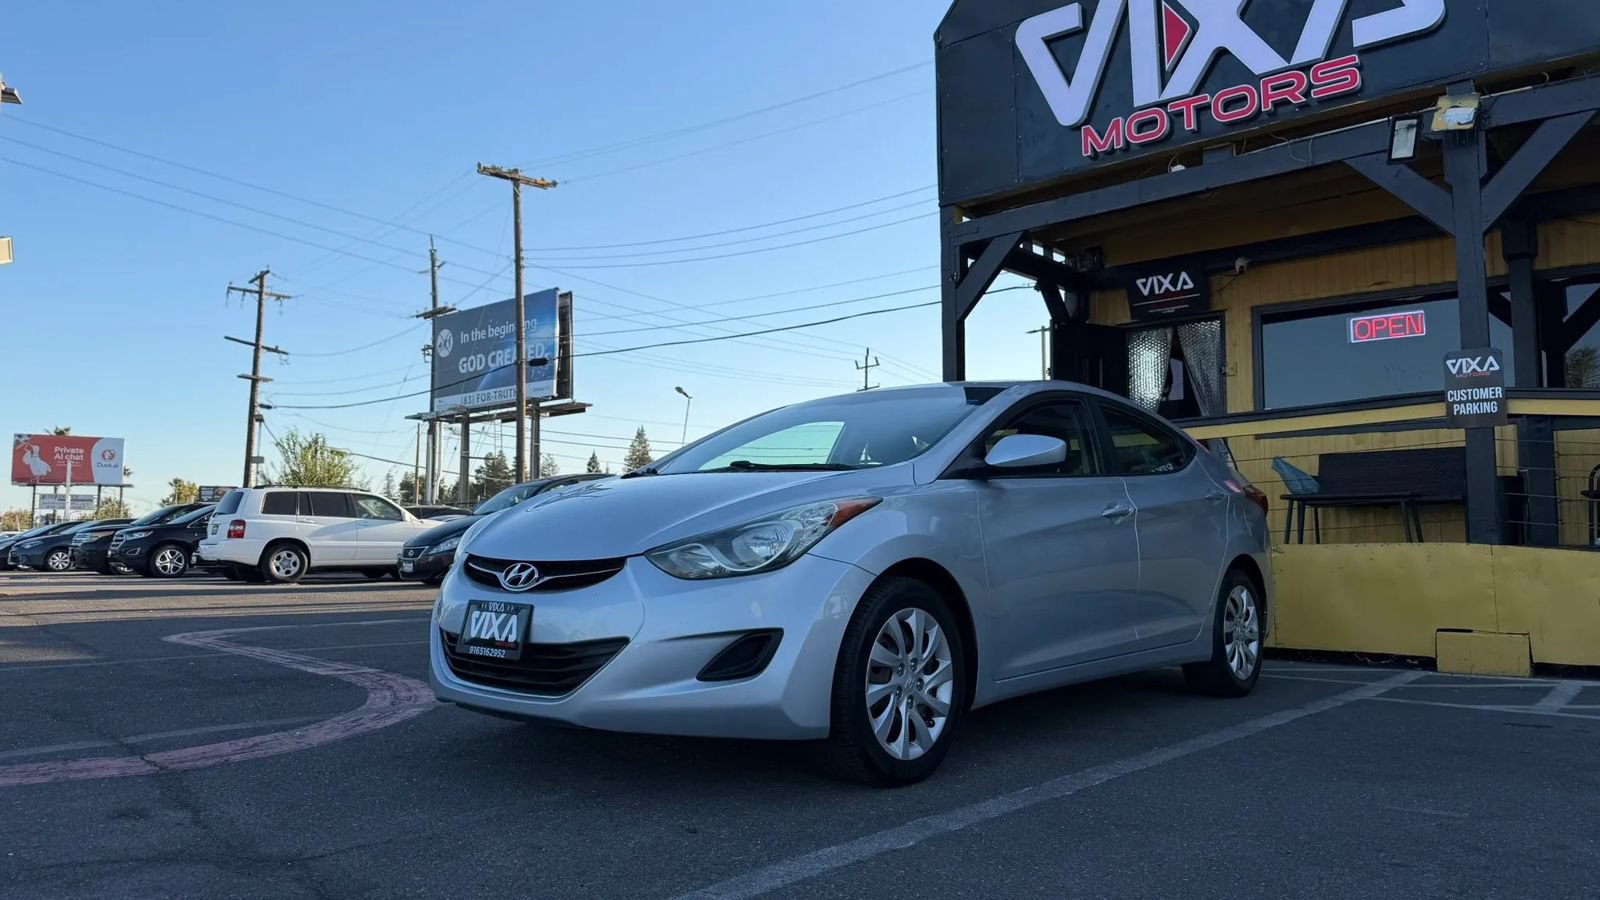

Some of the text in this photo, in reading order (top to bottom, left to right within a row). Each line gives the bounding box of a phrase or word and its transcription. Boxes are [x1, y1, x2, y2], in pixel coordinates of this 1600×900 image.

[1081, 54, 1361, 158] MOTORS
[1135, 271, 1194, 296] VIXA
[460, 318, 537, 344] In the beginng
[1354, 314, 1423, 339] OPEN
[459, 353, 486, 373] GOD
[1446, 355, 1500, 375] VIXA
[1447, 386, 1503, 402] CUSTOMER
[1453, 401, 1498, 416] PARKING
[54, 446, 85, 455] Private
[64, 453, 84, 461] chat
[488, 602, 505, 612] VIXA
[470, 610, 518, 642] VIXA
[469, 645, 506, 658] 9165162952
